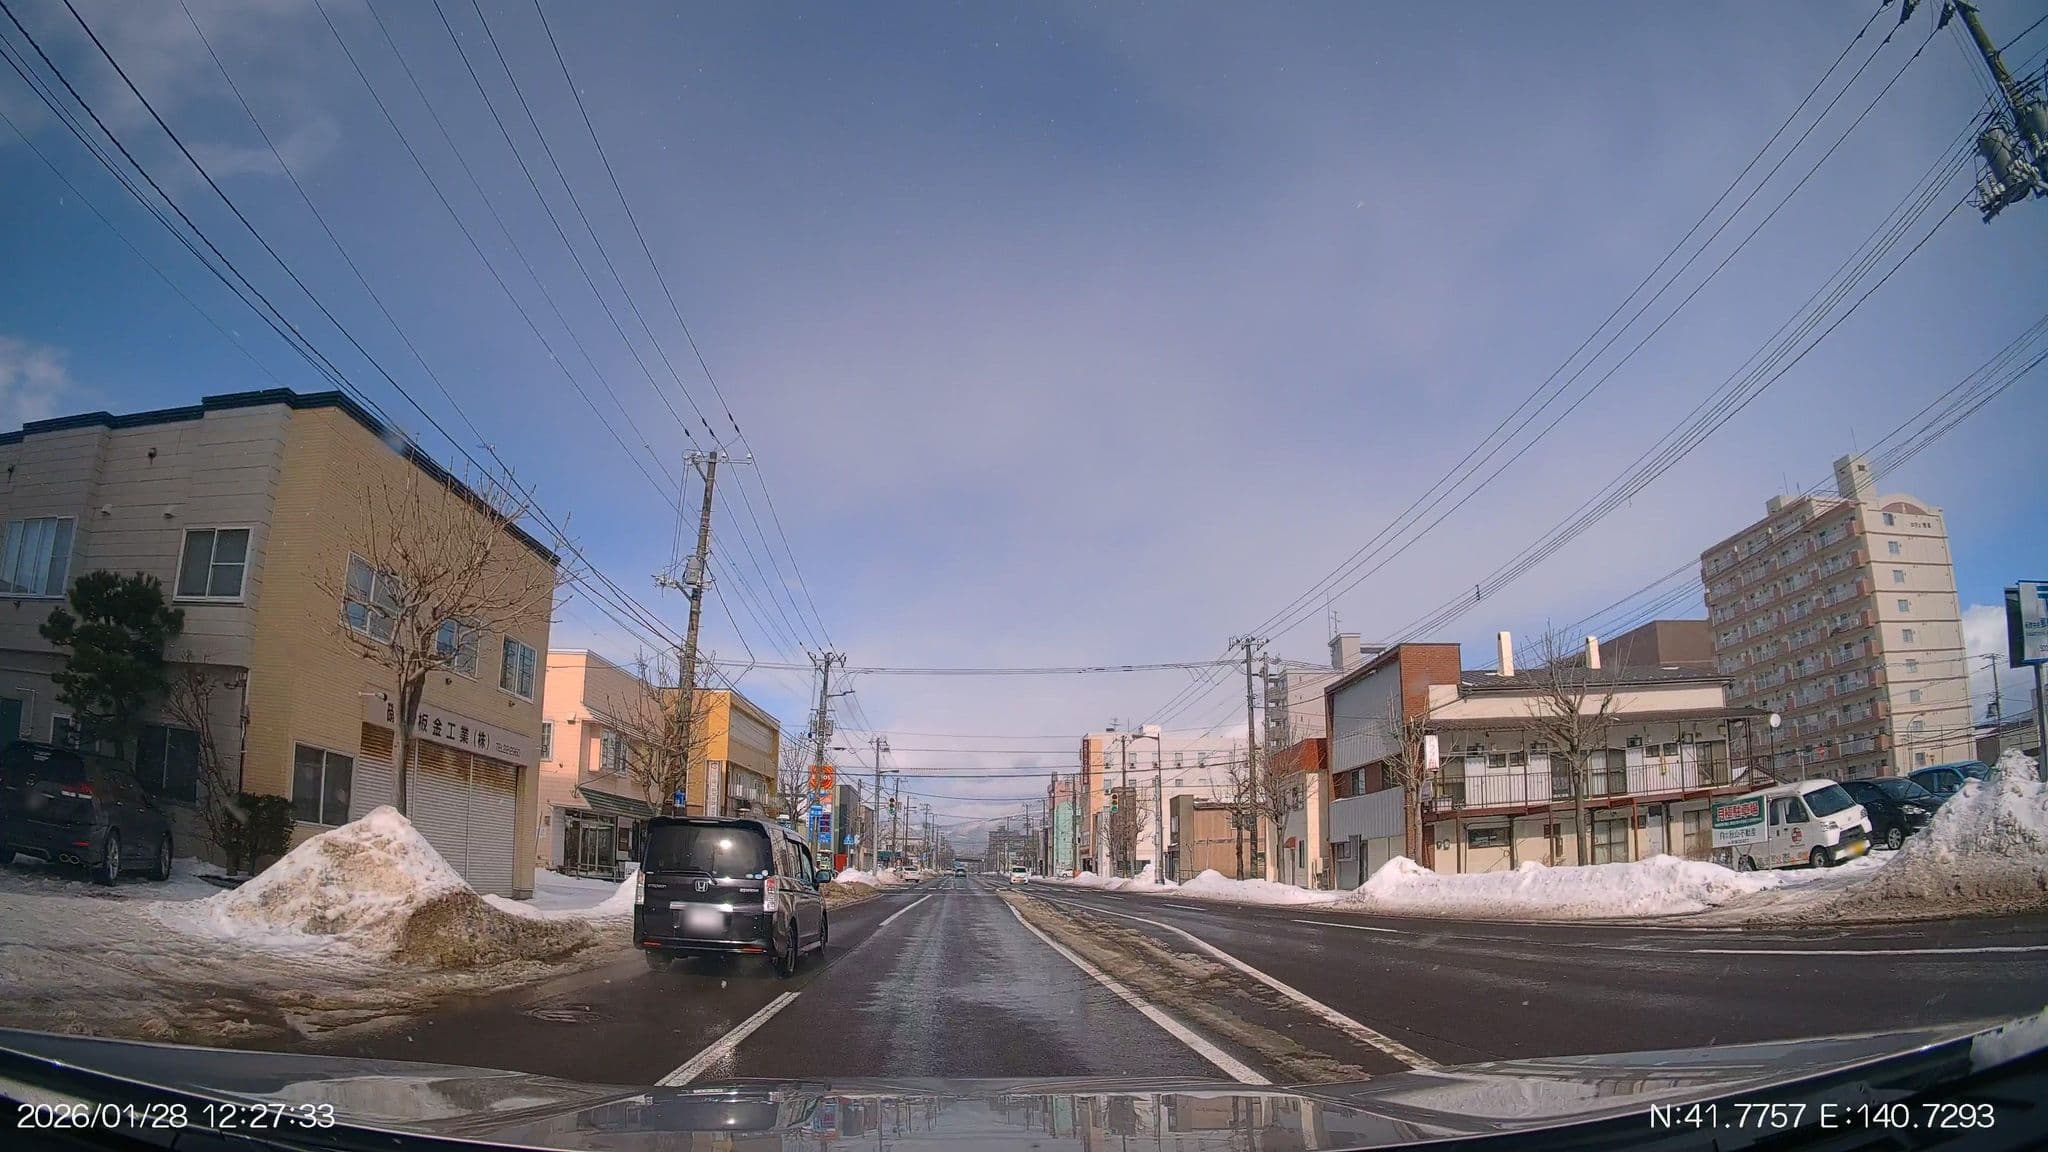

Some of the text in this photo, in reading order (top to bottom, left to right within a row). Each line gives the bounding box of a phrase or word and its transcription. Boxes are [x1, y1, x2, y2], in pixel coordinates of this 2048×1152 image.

[1717, 801, 1759, 821] 月極駐車場
